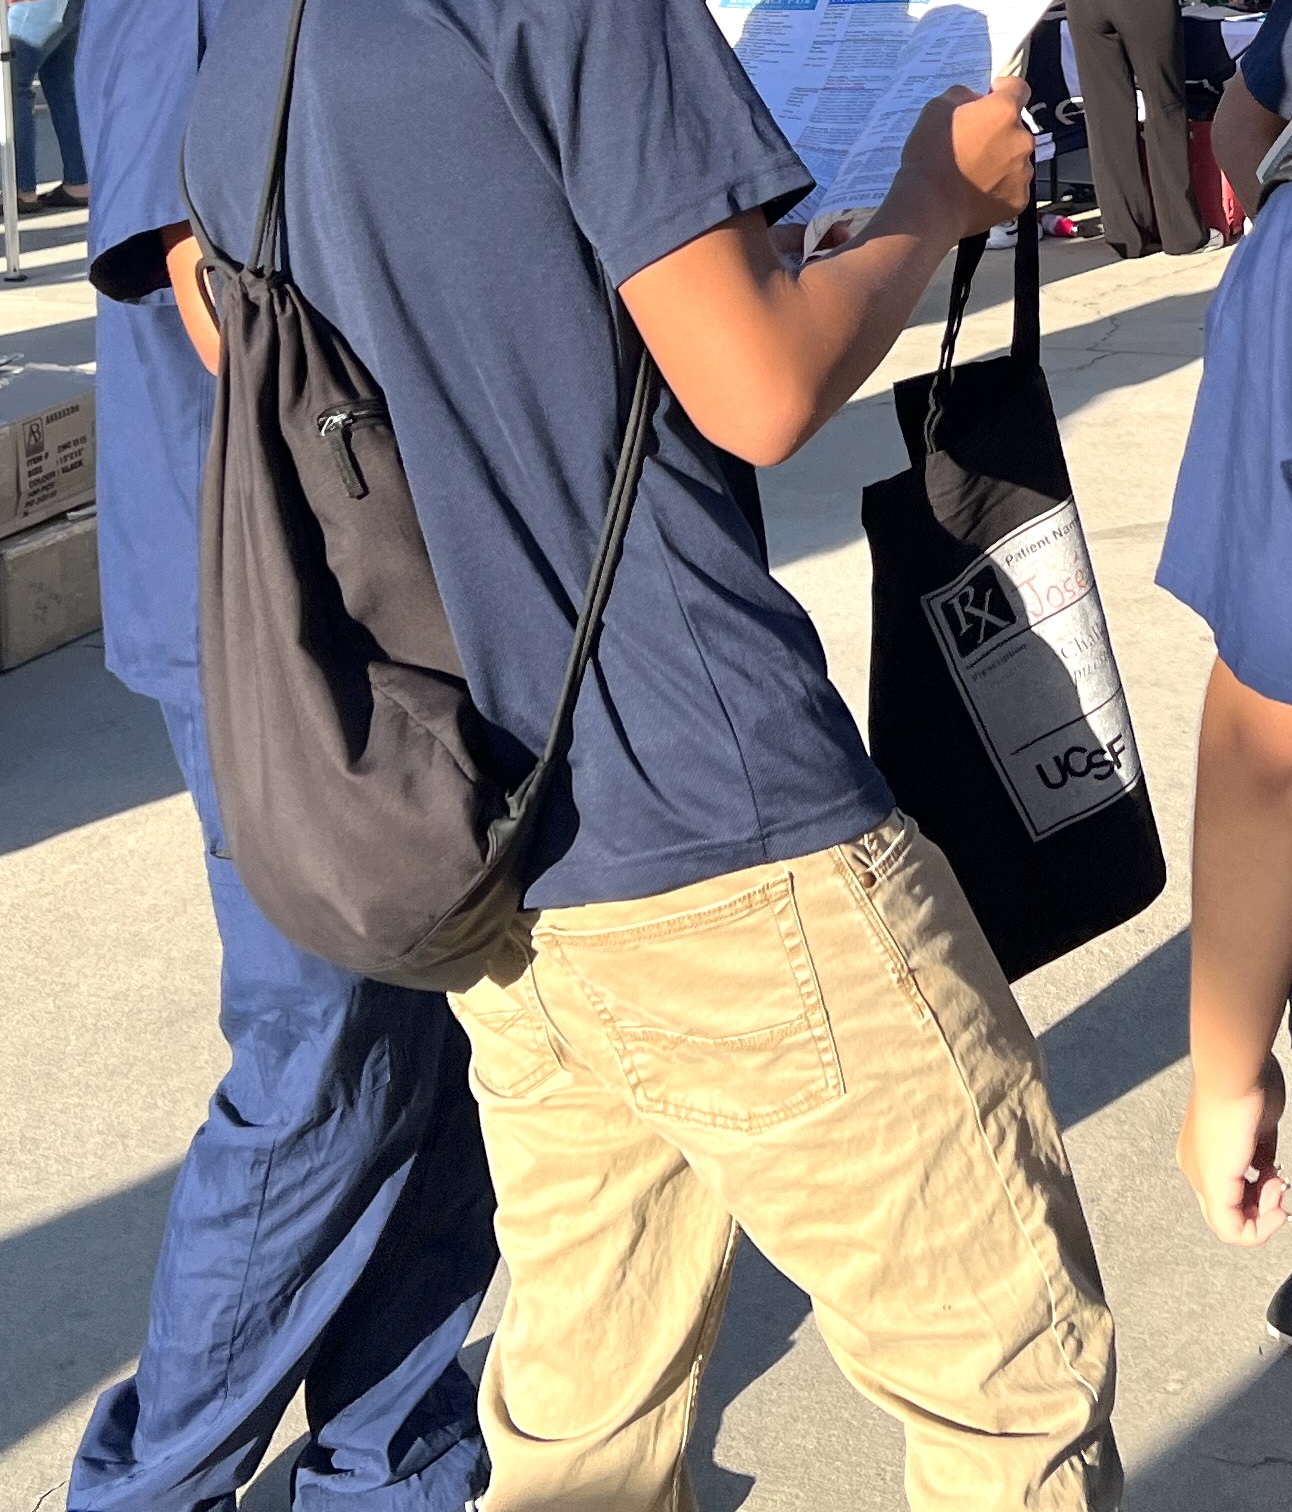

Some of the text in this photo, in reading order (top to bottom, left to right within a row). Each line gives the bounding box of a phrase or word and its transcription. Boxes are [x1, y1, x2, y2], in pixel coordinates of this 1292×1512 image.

[1005, 519, 1079, 567] Patient Nam
[1060, 621, 1108, 659] Chall
[1035, 734, 1126, 790] UCSF
